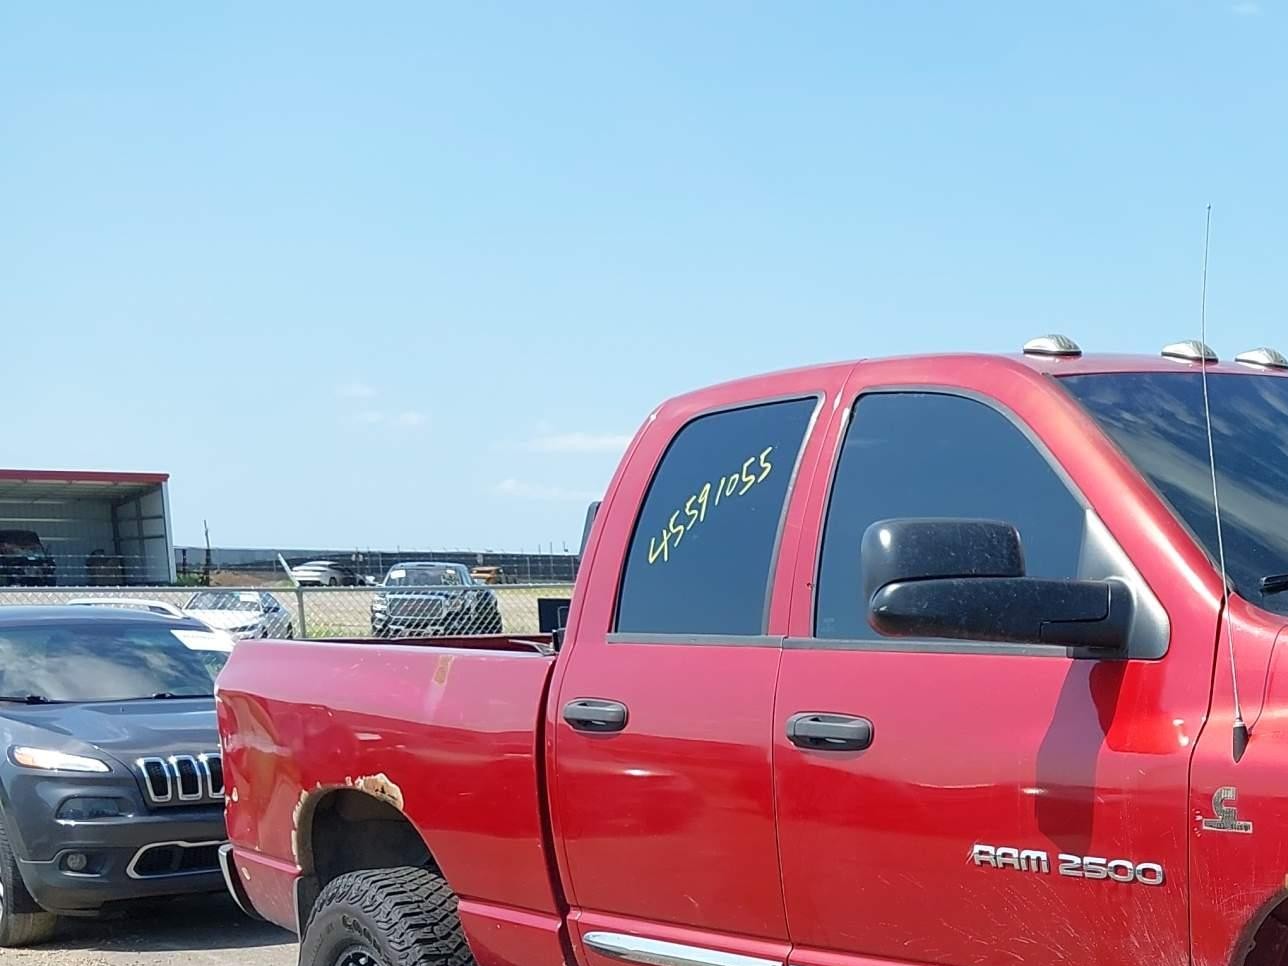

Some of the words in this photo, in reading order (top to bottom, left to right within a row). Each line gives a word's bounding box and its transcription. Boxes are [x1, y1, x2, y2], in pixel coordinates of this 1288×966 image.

[647, 446, 773, 564] 45591055
[972, 844, 1049, 873] RAM
[1058, 853, 1165, 886] 2500
